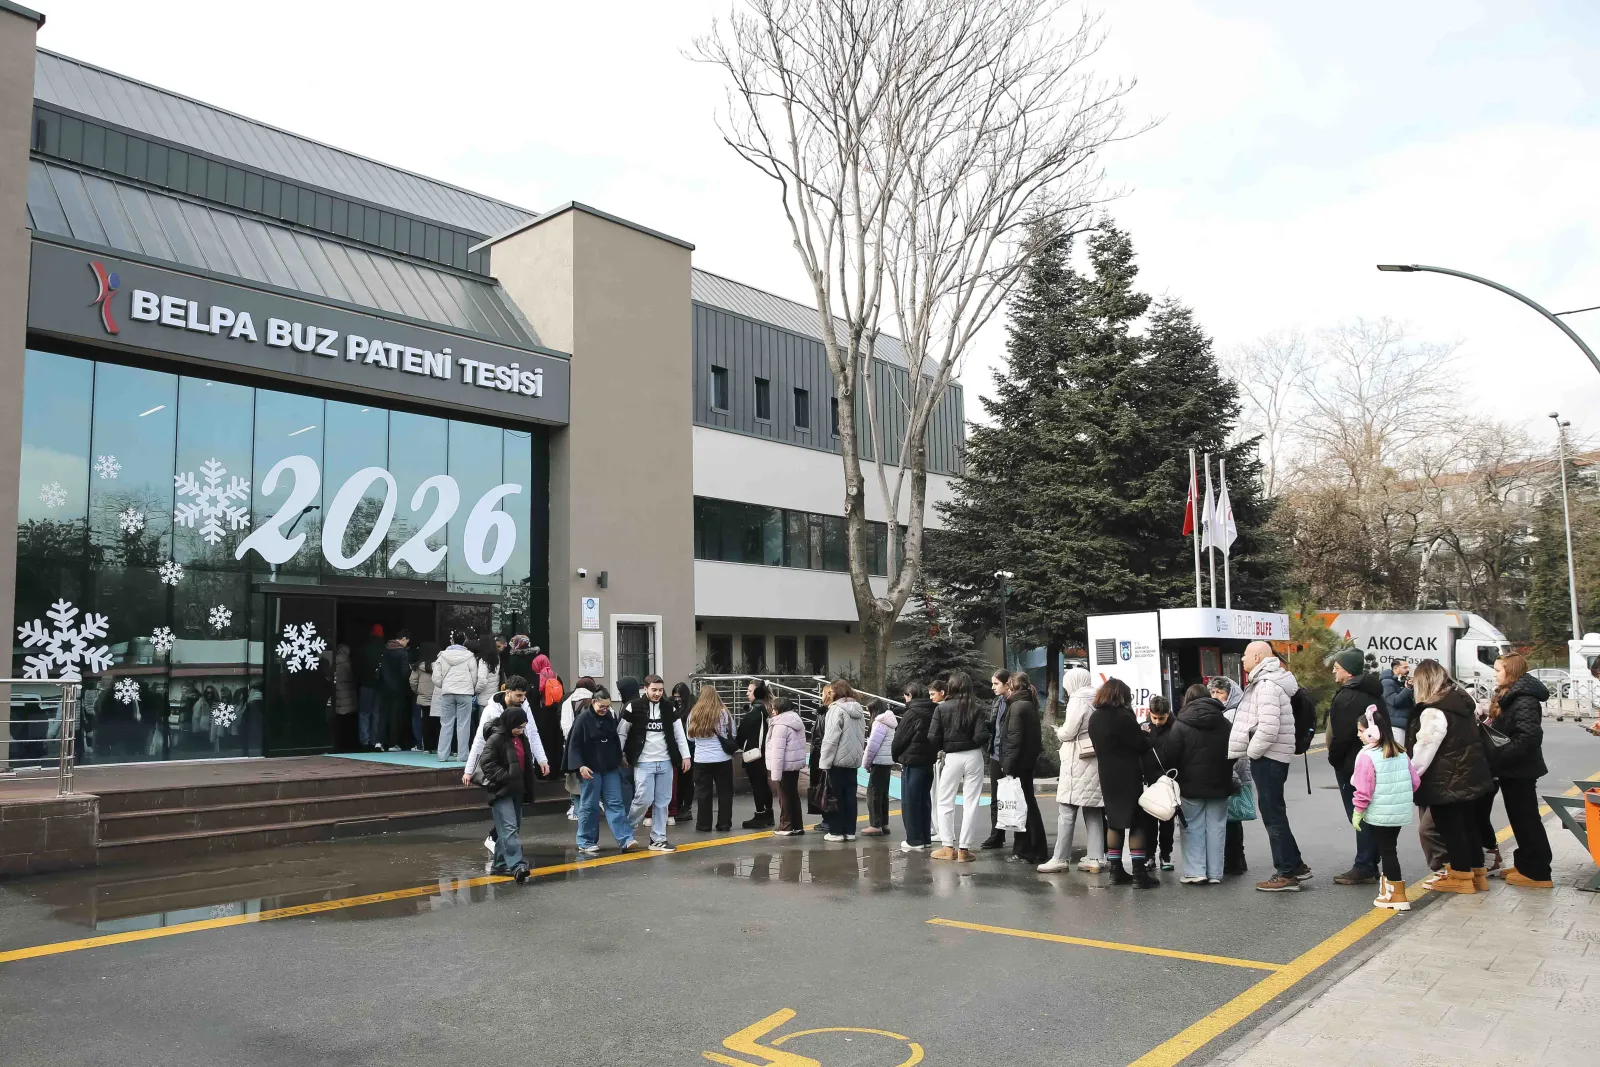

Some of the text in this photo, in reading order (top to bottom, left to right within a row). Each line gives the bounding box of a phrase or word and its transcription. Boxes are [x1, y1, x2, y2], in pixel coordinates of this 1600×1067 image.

[130, 289, 258, 342] BELPA
[266, 317, 339, 358] BUZ
[346, 334, 452, 380] PATENİ
[235, 455, 522, 576] 2026
[1366, 636, 1438, 651] AKOCAK
